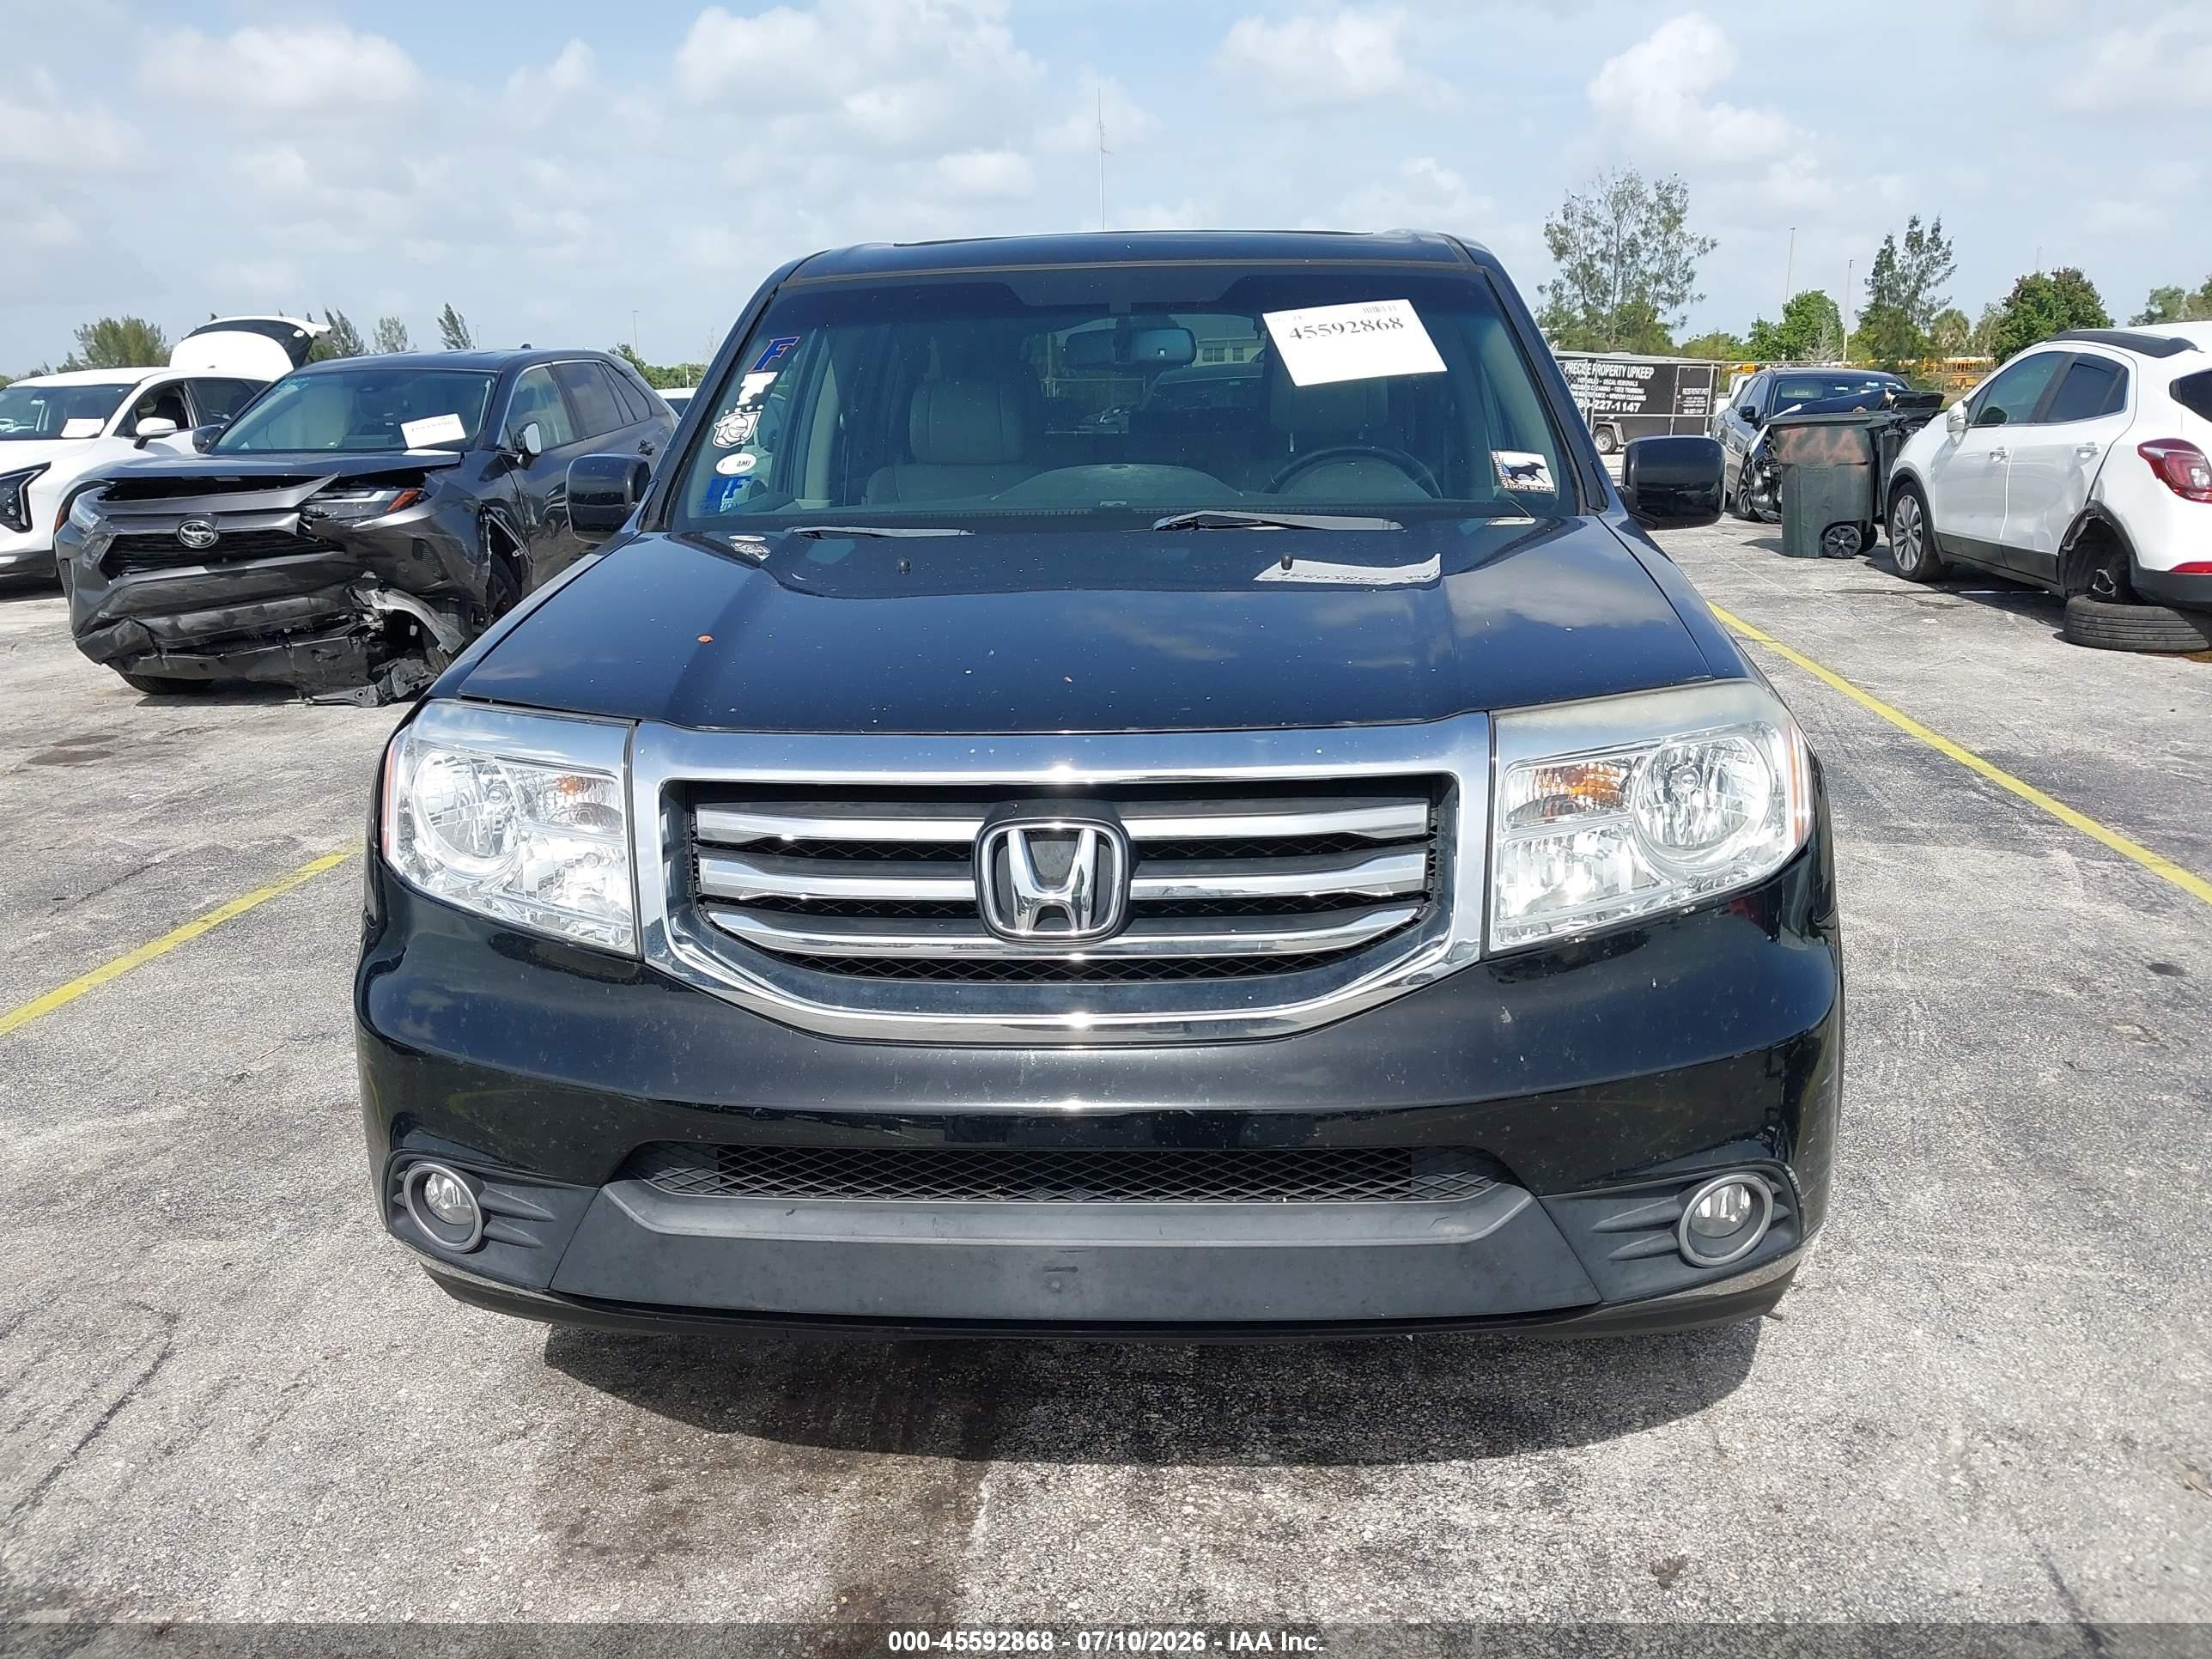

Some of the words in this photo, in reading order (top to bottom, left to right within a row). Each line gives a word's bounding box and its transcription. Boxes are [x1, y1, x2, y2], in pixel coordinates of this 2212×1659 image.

[1290, 317, 1404, 339] 45592868
[1564, 362, 1592, 375] PRECISE
[1592, 363, 1627, 377] PROPERTY
[1627, 366, 1655, 380] UPKEEP
